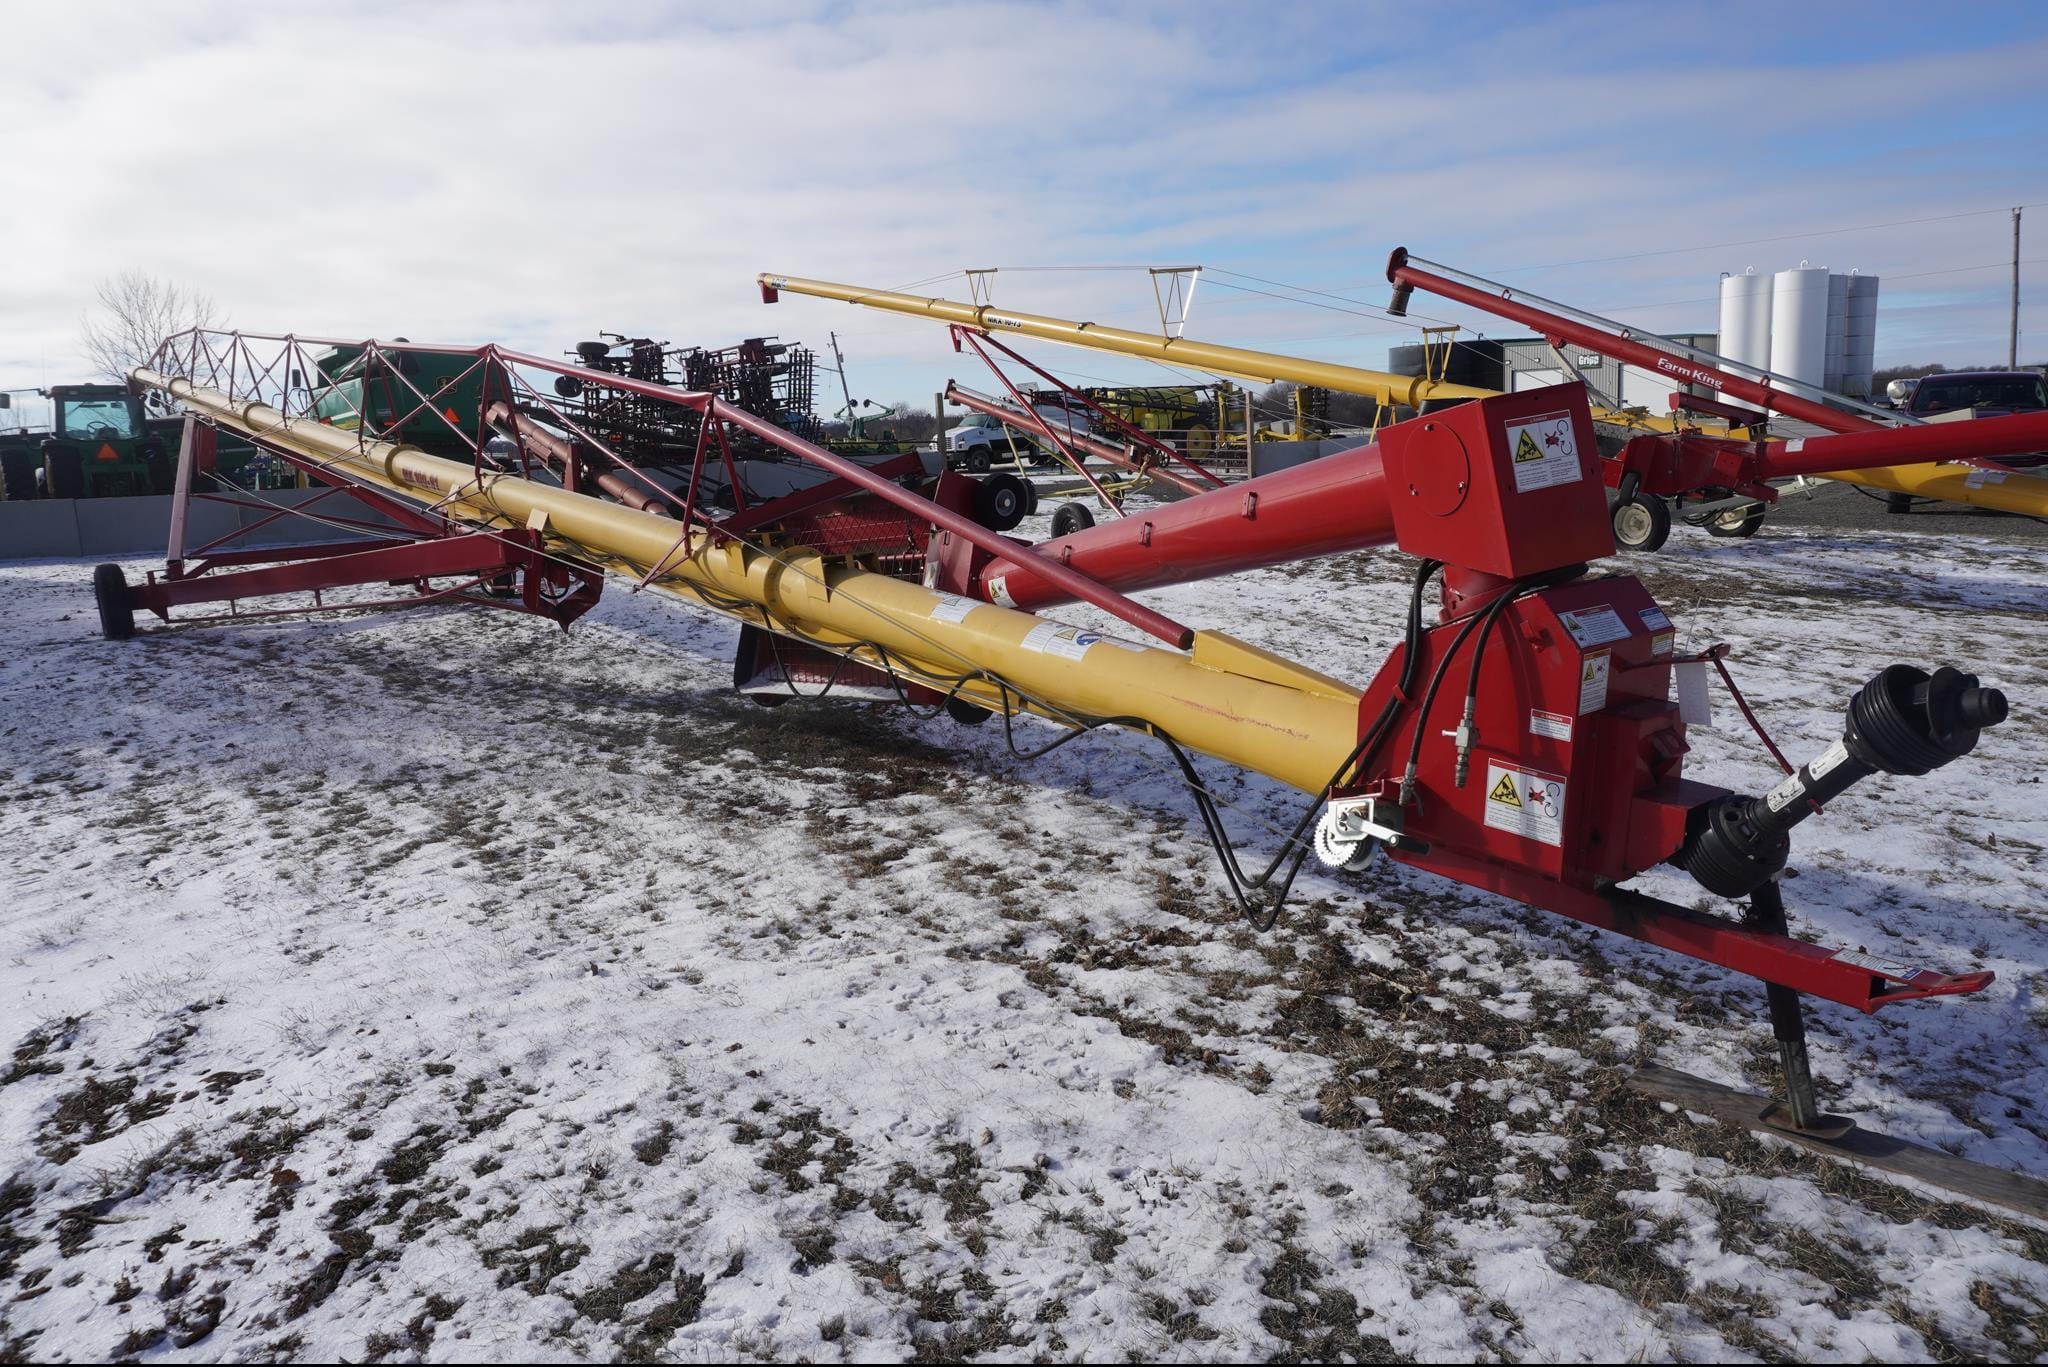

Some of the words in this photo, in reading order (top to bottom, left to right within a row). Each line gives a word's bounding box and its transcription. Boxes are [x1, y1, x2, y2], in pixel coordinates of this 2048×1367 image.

[1579, 354, 1599, 365] Gripp
[1657, 358, 1690, 376] Farm
[1692, 365, 1724, 389] King
